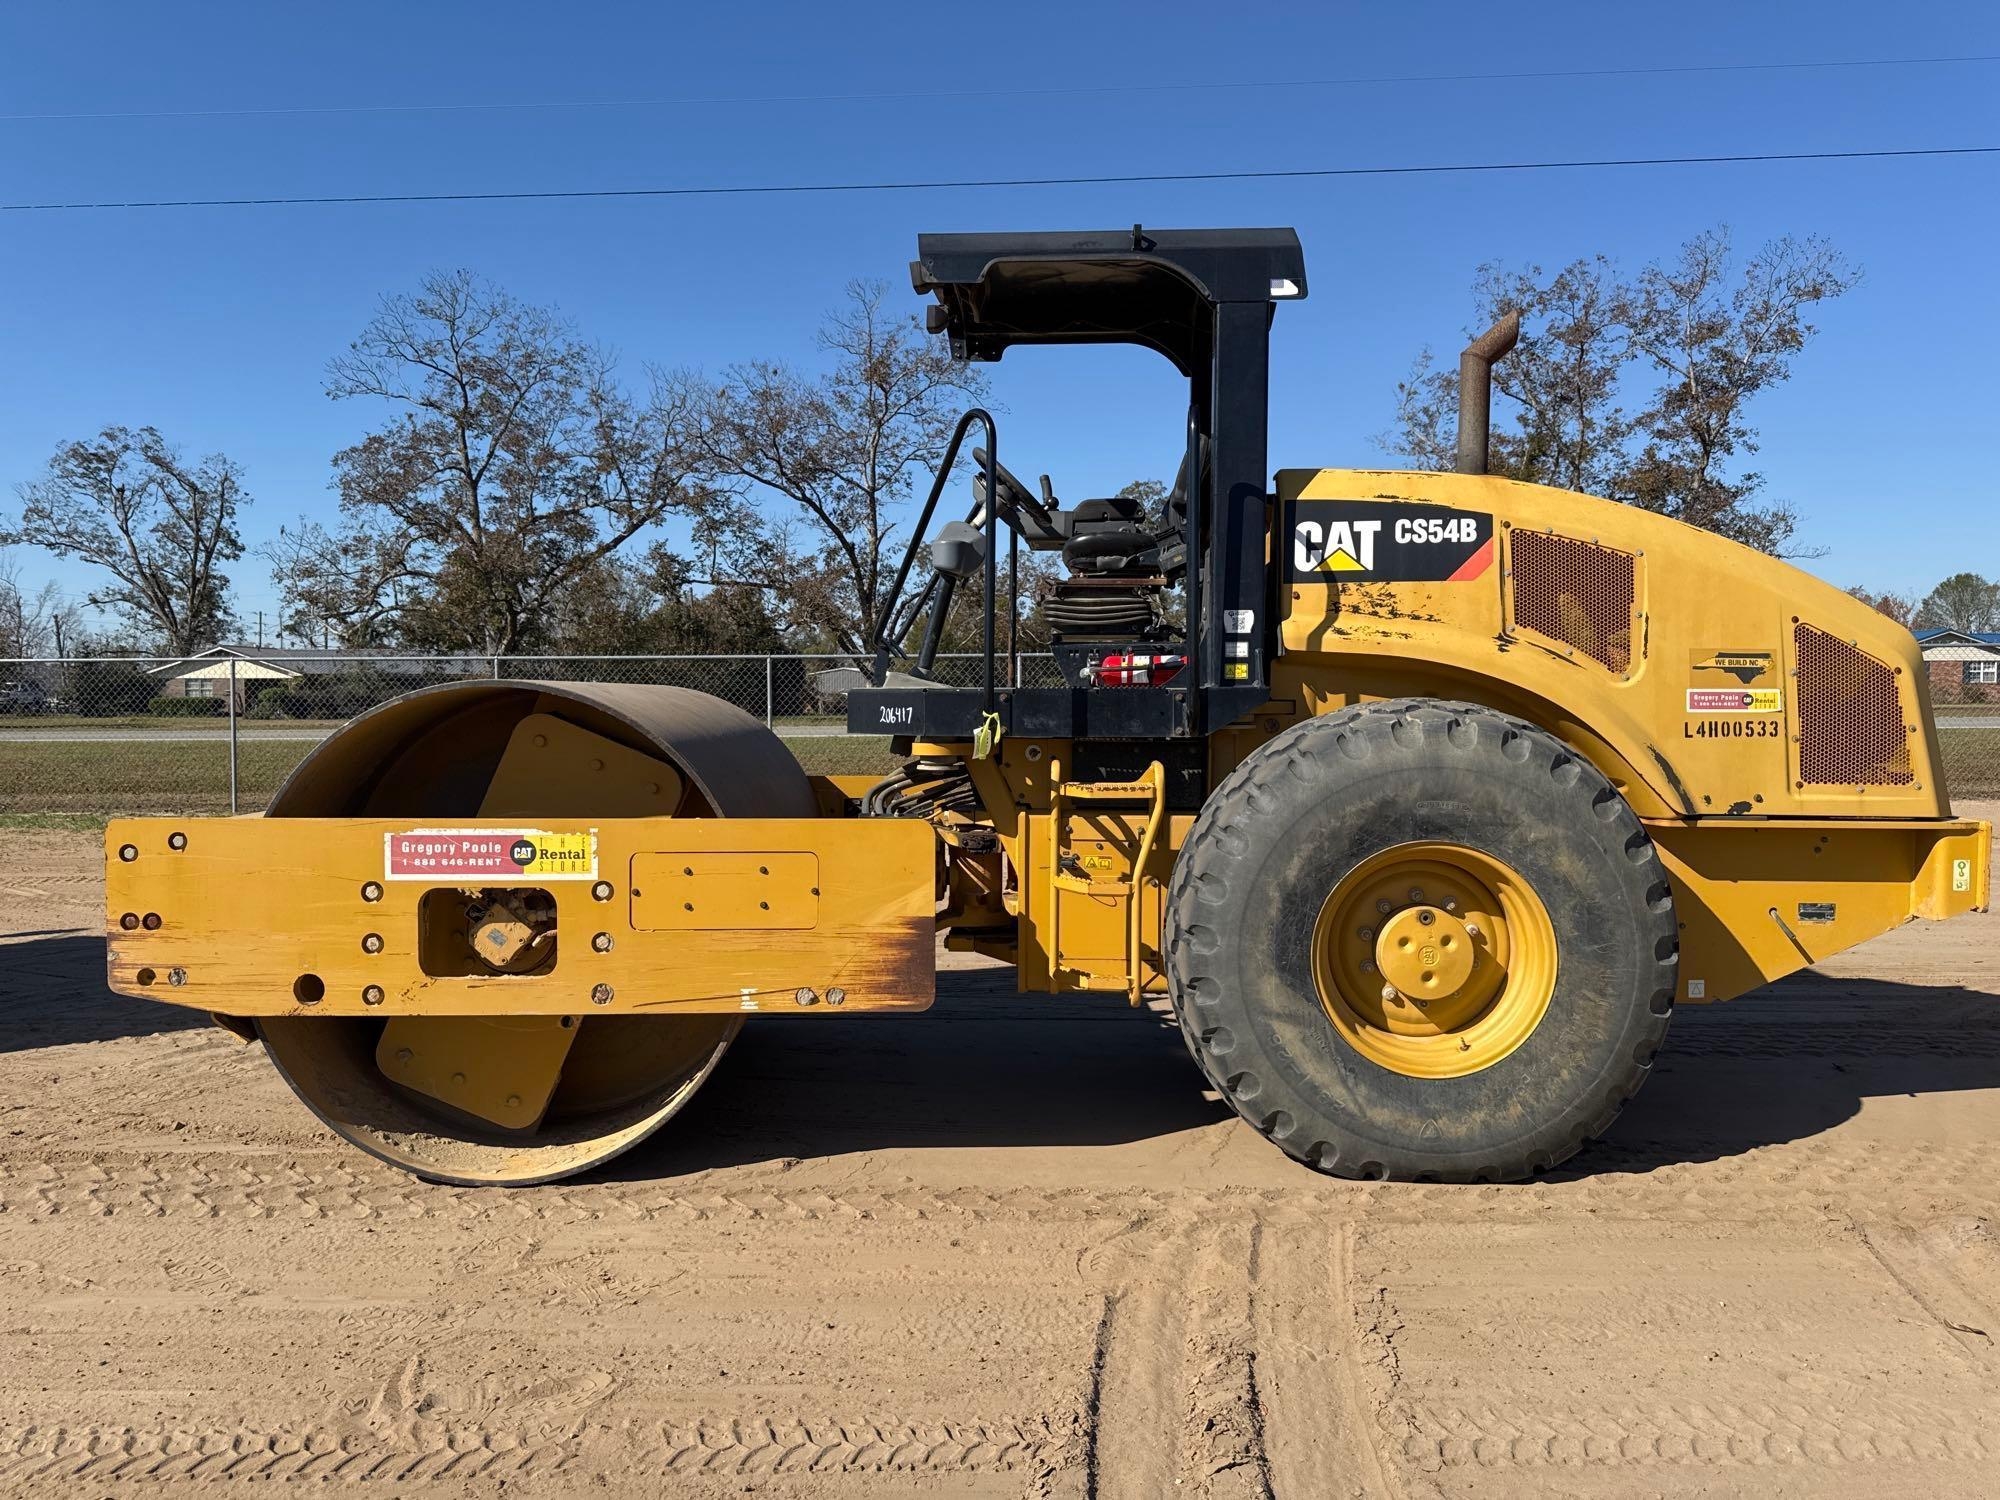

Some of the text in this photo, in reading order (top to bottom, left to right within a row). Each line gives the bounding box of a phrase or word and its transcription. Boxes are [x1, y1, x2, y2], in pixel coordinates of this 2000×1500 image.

[1395, 518, 1477, 544] CS54B
[1294, 520, 1382, 572] CAT
[879, 706, 913, 724] 206417
[1684, 721, 1779, 738] L4H00533
[401, 841, 502, 855] Gregory Poole
[539, 837, 587, 849] THE
[513, 846, 533, 860] CAT
[539, 848, 587, 860] Rental
[539, 860, 589, 872] STORE
